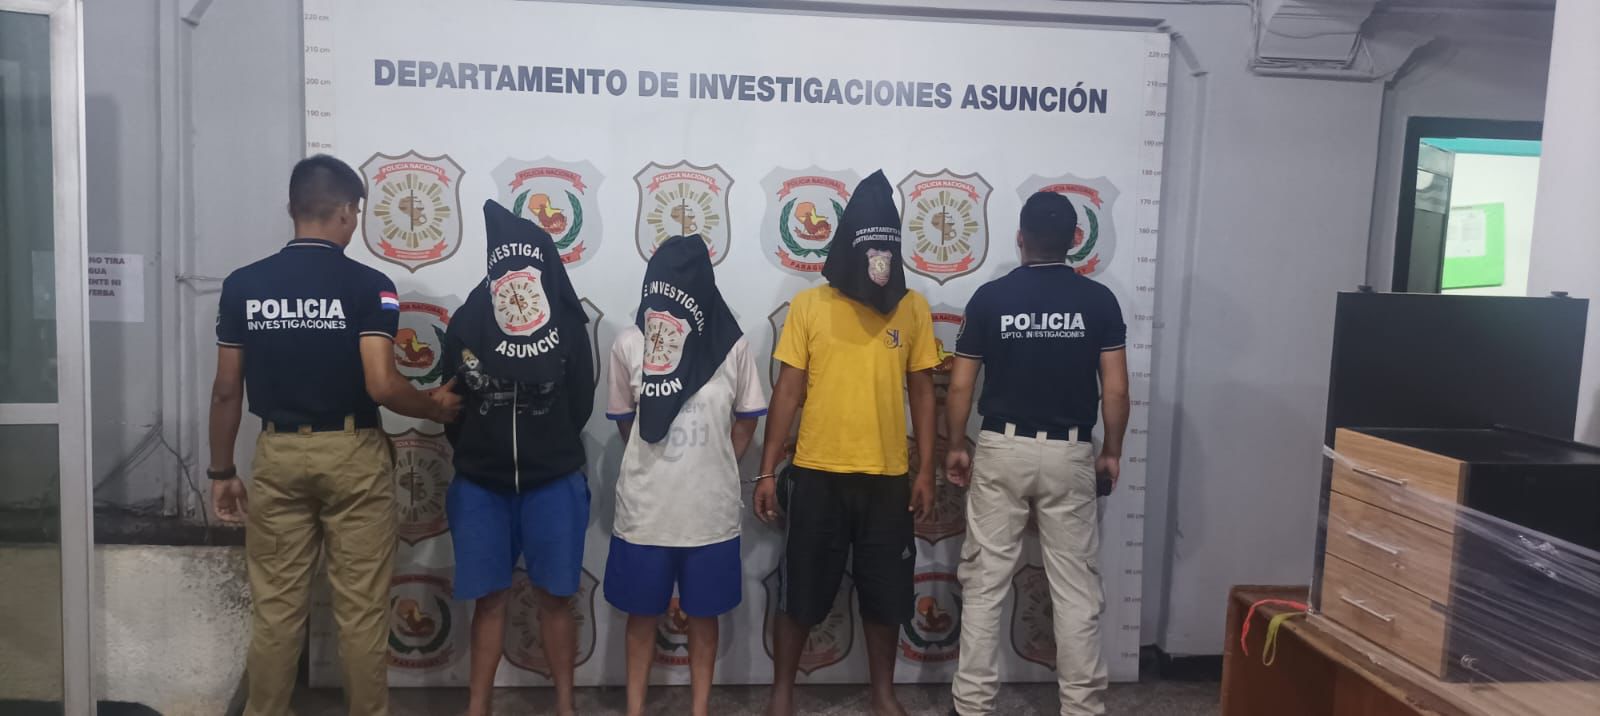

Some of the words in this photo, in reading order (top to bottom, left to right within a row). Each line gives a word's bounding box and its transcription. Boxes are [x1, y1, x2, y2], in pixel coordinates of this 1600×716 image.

[374, 58, 628, 97] DEPARTAMENTO
[638, 70, 679, 98] DE
[689, 72, 953, 109] INVESTIGACIONES
[960, 81, 1108, 114] ASUNCIÓN
[382, 164, 408, 174] POLICIA
[410, 163, 443, 175] NACIONAL
[656, 172, 680, 183] POLICIA
[682, 172, 713, 184] NACIONAL
[917, 180, 943, 191] POLICIA
[944, 180, 974, 193] NACIONAL
[88, 256, 102, 264] NO
[88, 267, 107, 275] GUA
[246, 298, 346, 320] POLICIA
[248, 319, 346, 330] INVESTIGACIONES
[1000, 312, 1085, 332] POLICIA
[495, 327, 560, 358] ASUNCIÓ
